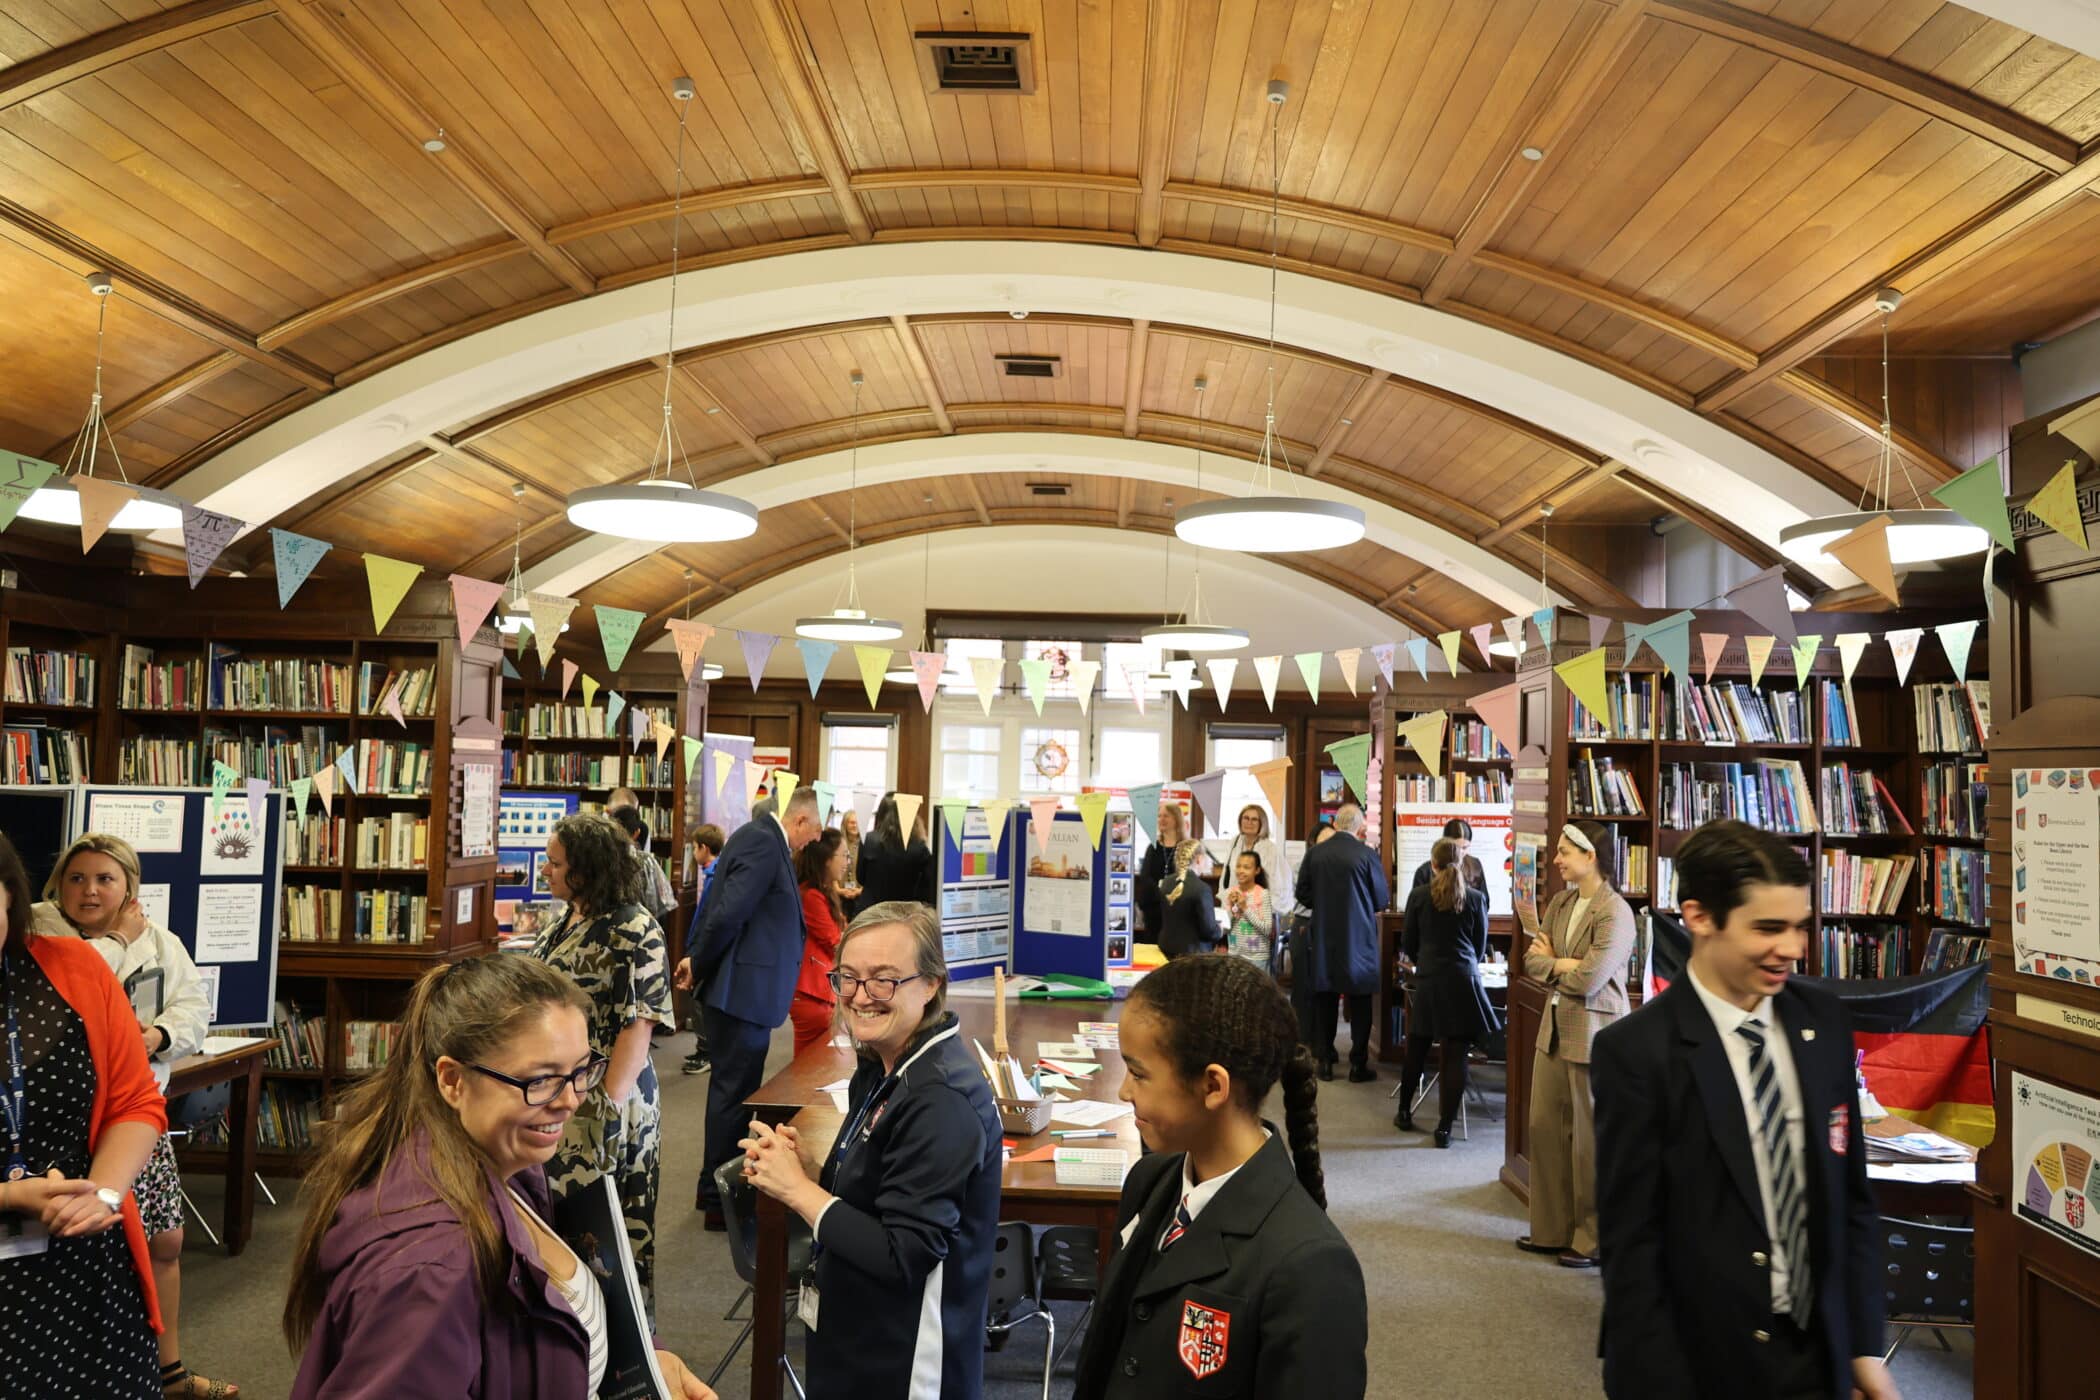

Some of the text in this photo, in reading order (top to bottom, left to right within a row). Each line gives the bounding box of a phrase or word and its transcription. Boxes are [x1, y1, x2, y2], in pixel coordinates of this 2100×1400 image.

[1415, 816, 1440, 825] Senior
[1468, 817, 1504, 828] Language
[1047, 831, 1080, 845] ALIAN
